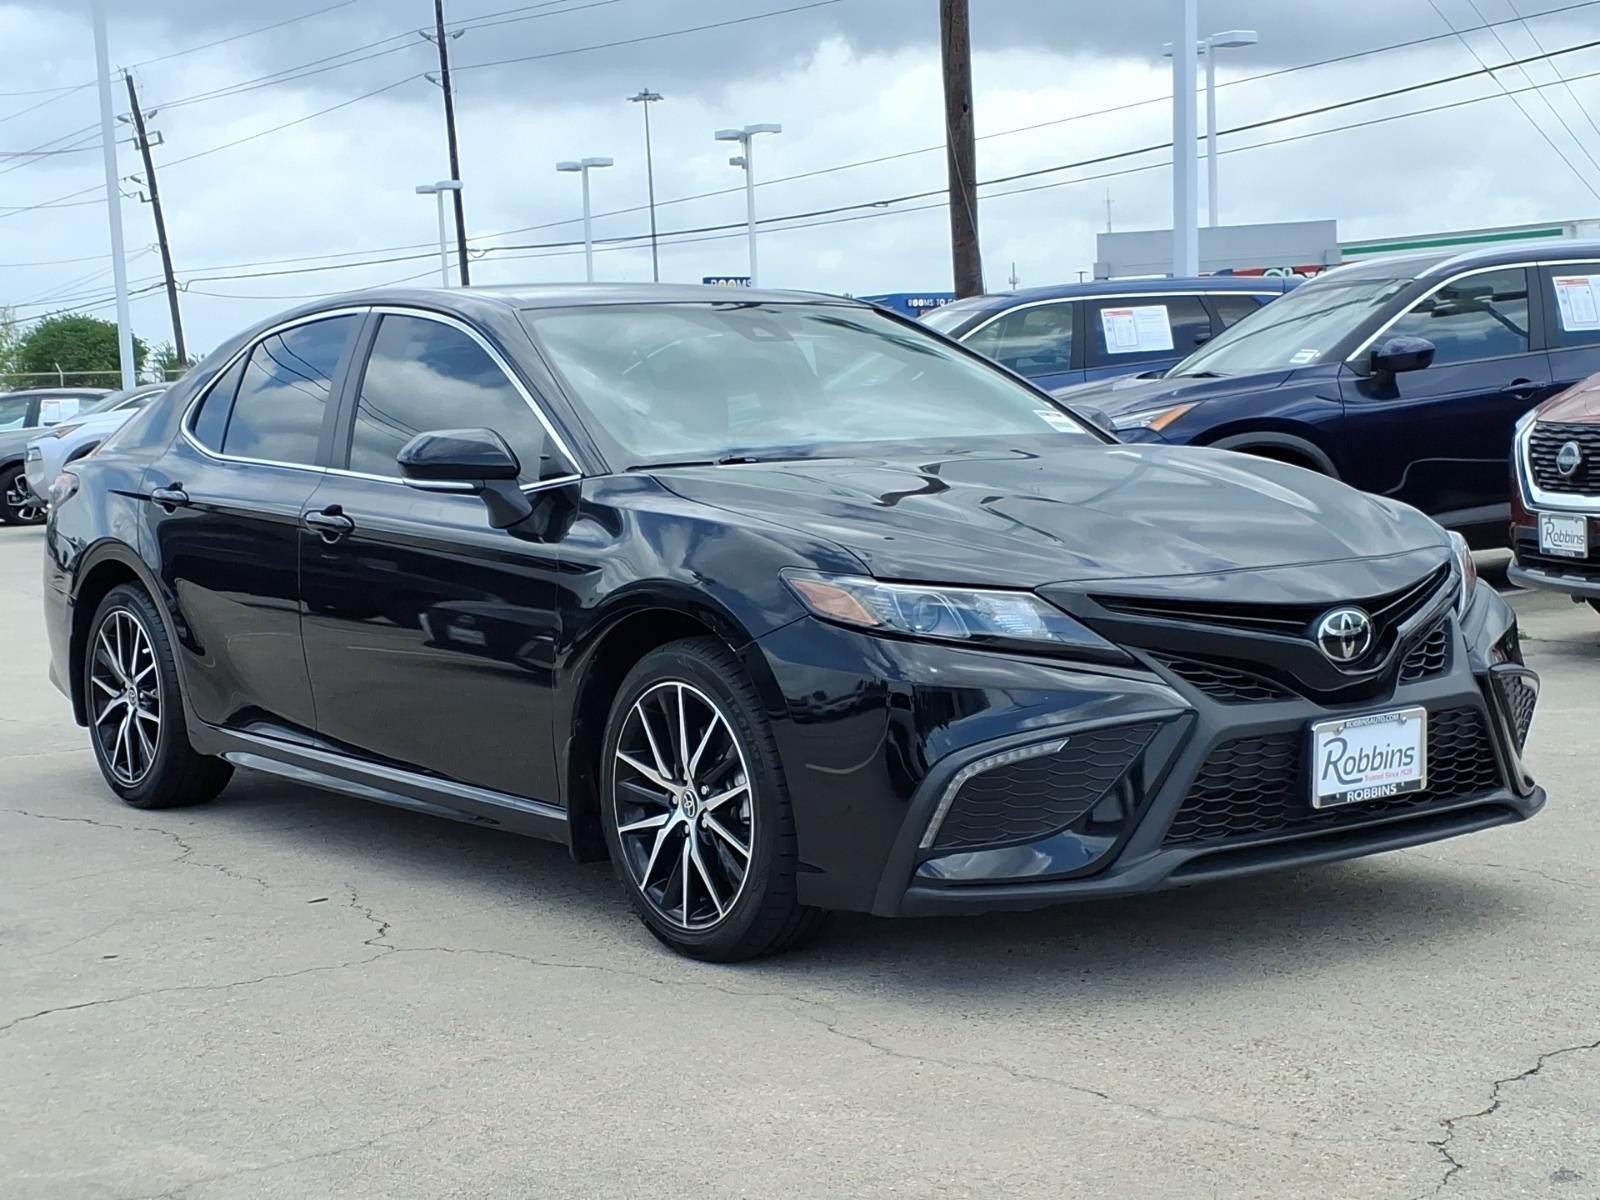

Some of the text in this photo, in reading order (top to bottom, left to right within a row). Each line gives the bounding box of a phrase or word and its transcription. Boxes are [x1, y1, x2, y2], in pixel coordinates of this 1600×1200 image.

[907, 299, 934, 307] ROOMS
[1544, 520, 1585, 547] Robbins
[1322, 737, 1415, 785] Robbins
[1347, 784, 1397, 802] ROBBINS
